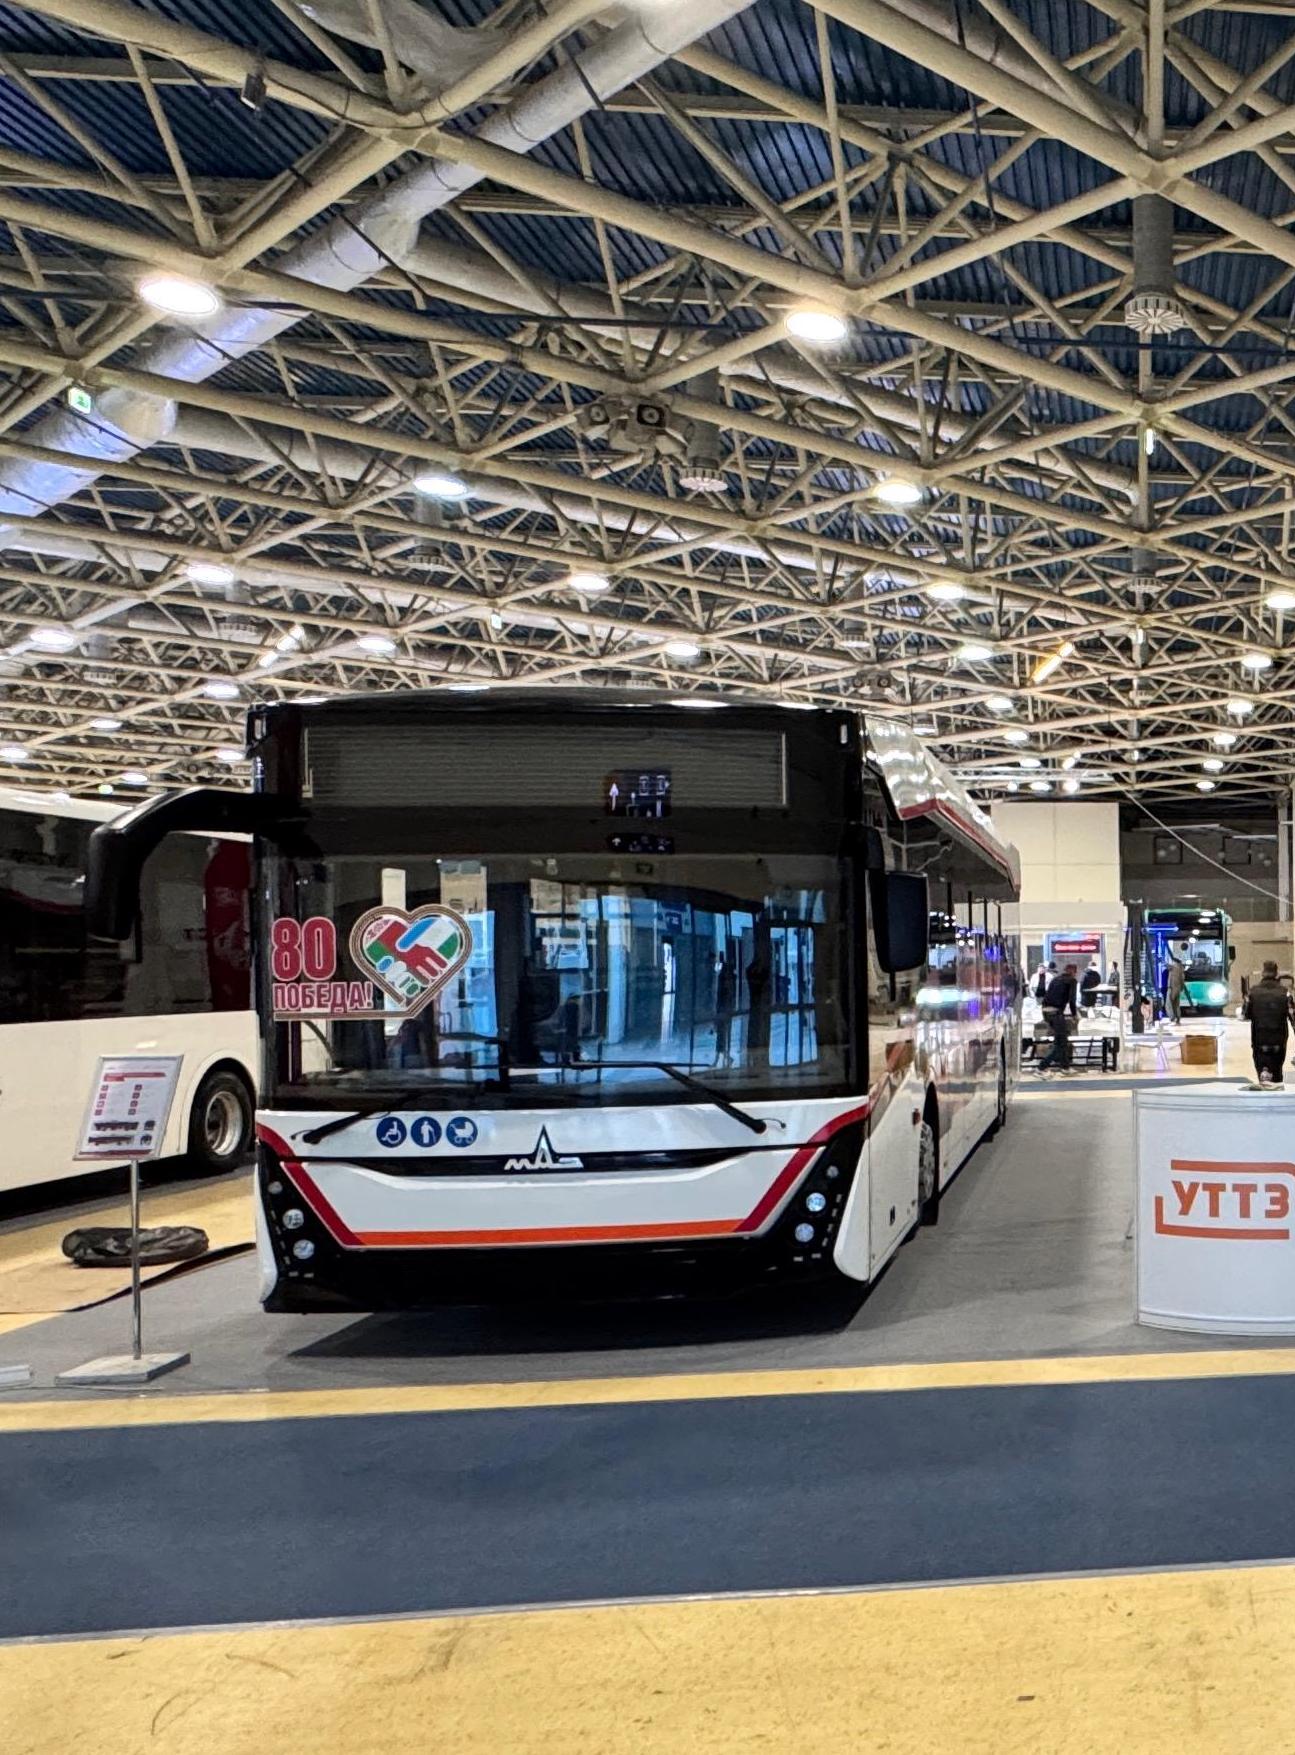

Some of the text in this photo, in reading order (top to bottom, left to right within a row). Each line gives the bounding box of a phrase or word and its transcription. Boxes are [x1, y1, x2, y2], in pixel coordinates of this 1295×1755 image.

[272, 917, 336, 980] 80
[273, 982, 373, 1012] ПОБЕДА!
[1171, 1180, 1290, 1219] УТТЗ
